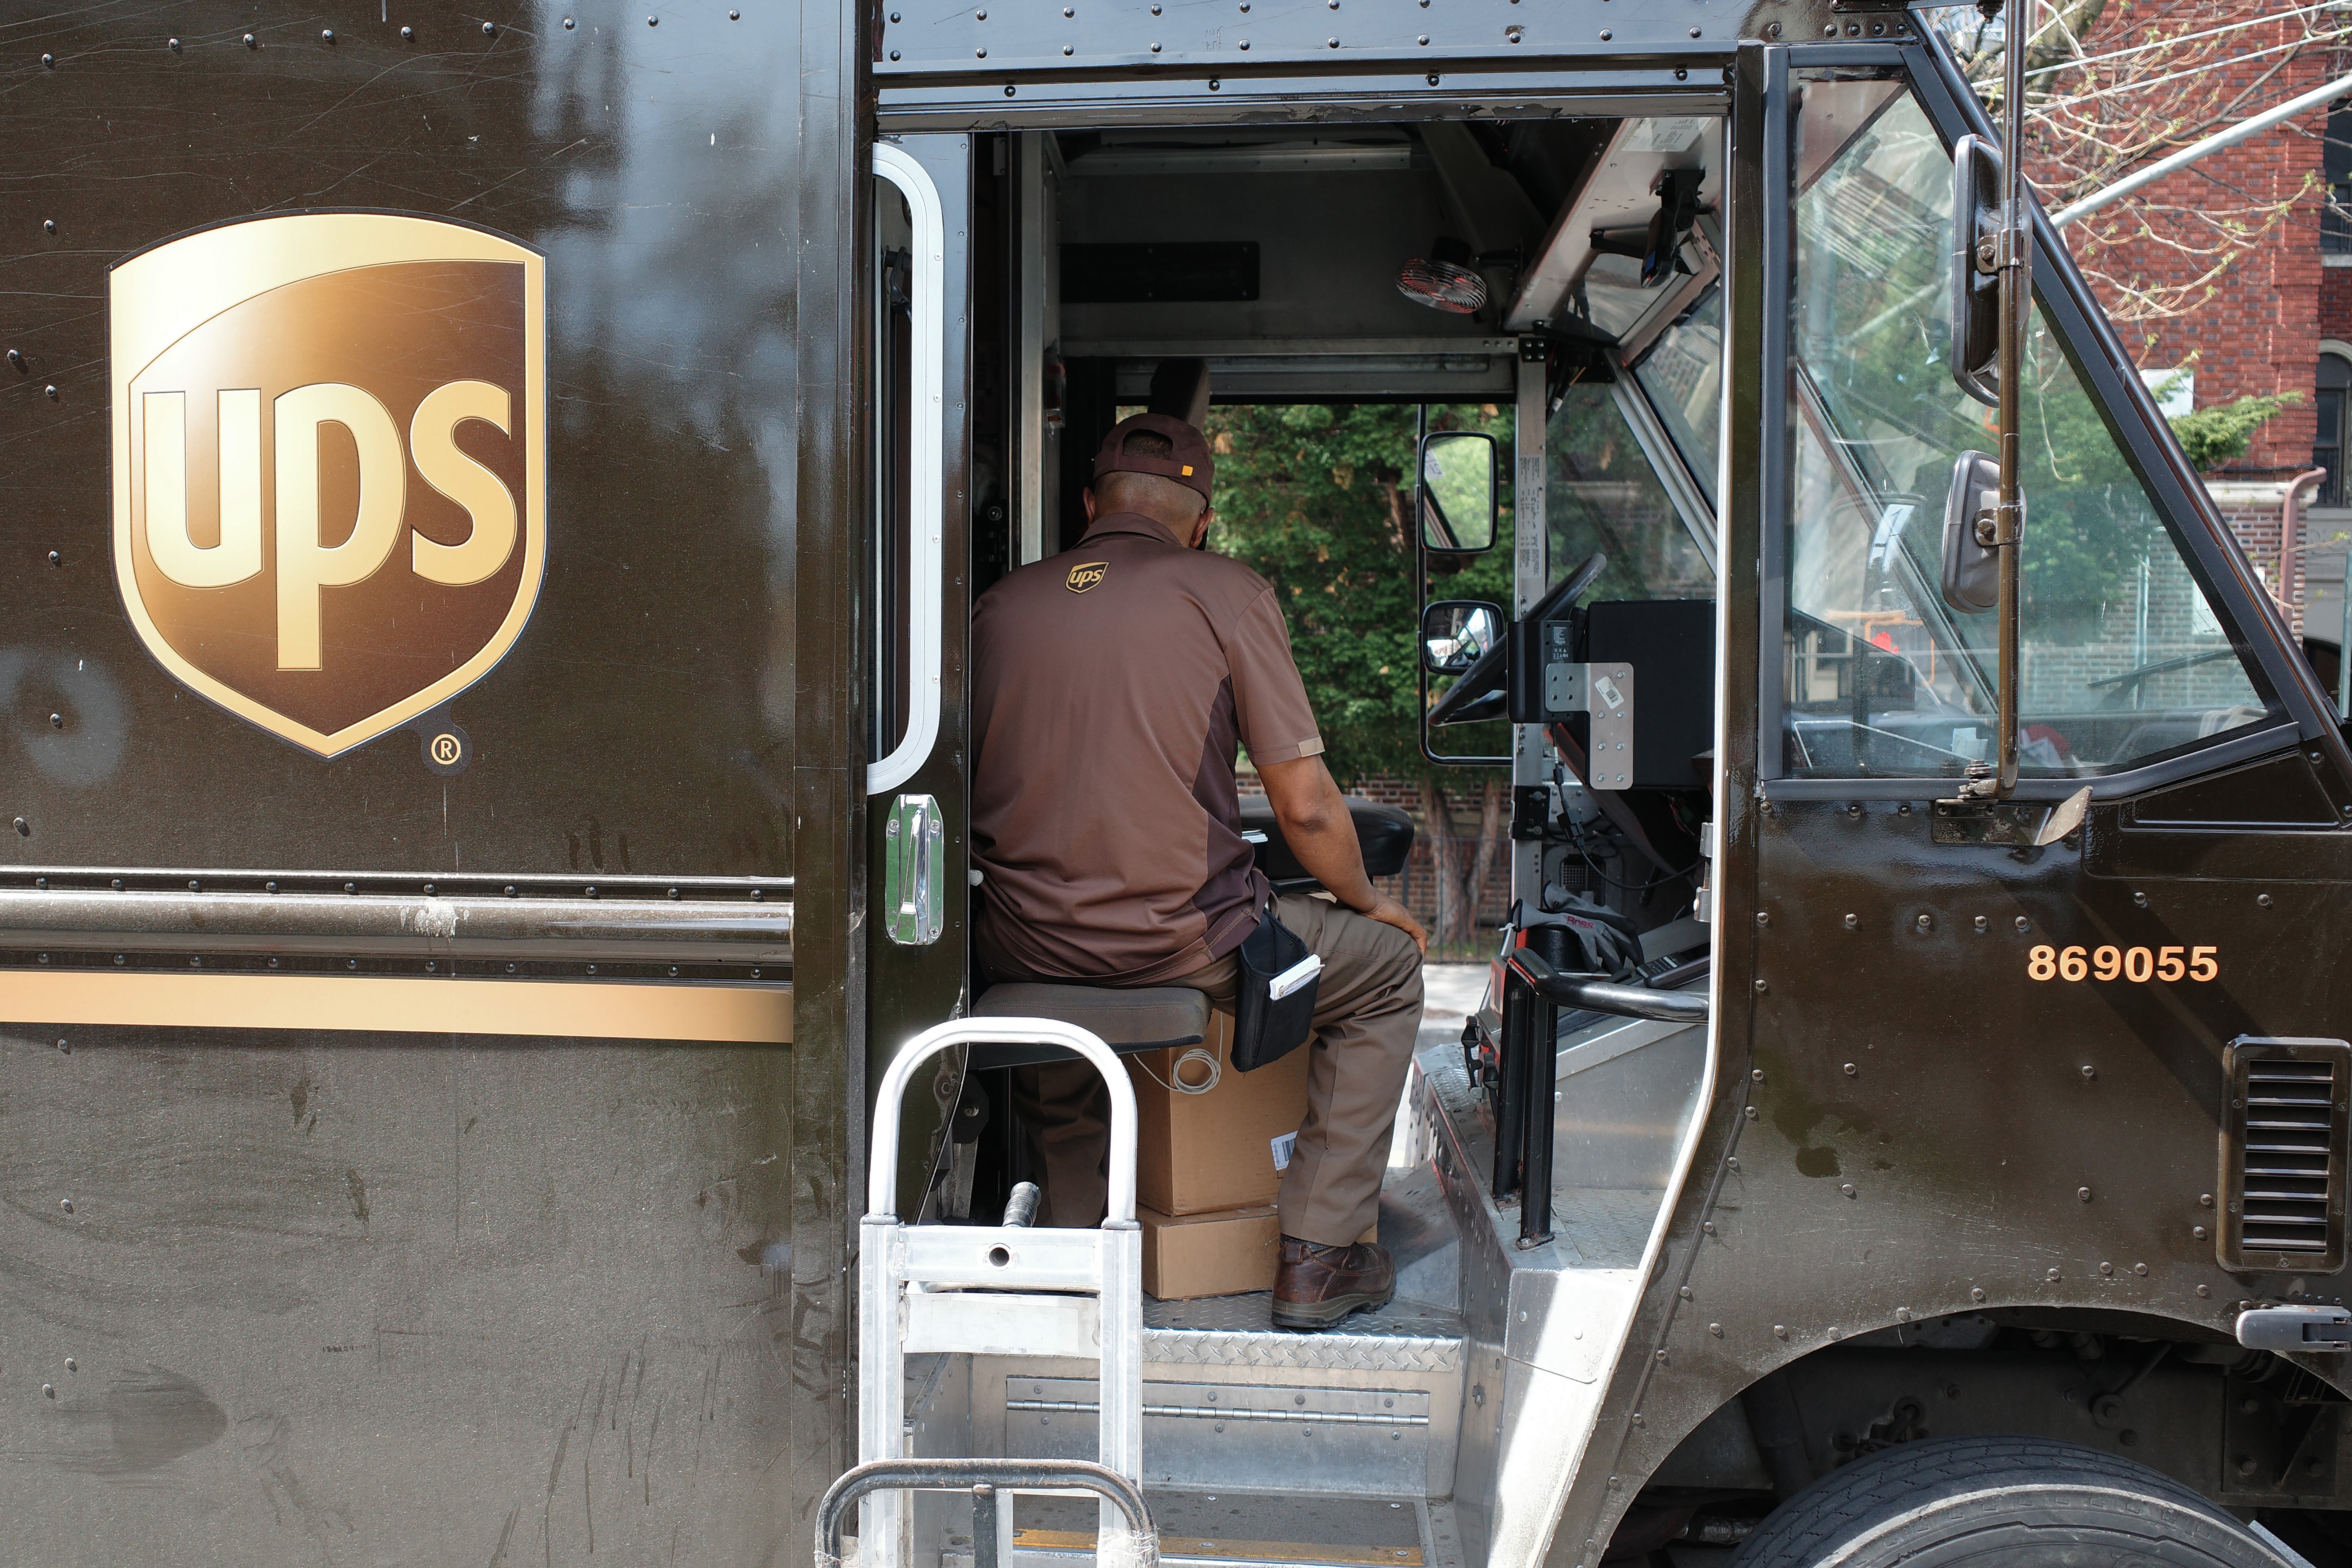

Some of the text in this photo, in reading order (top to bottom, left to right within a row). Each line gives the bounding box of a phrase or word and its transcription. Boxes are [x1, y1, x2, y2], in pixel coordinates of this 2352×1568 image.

[143, 379, 517, 670] ups
[1069, 569, 1103, 588] ups
[2028, 945, 2219, 982] 869055
